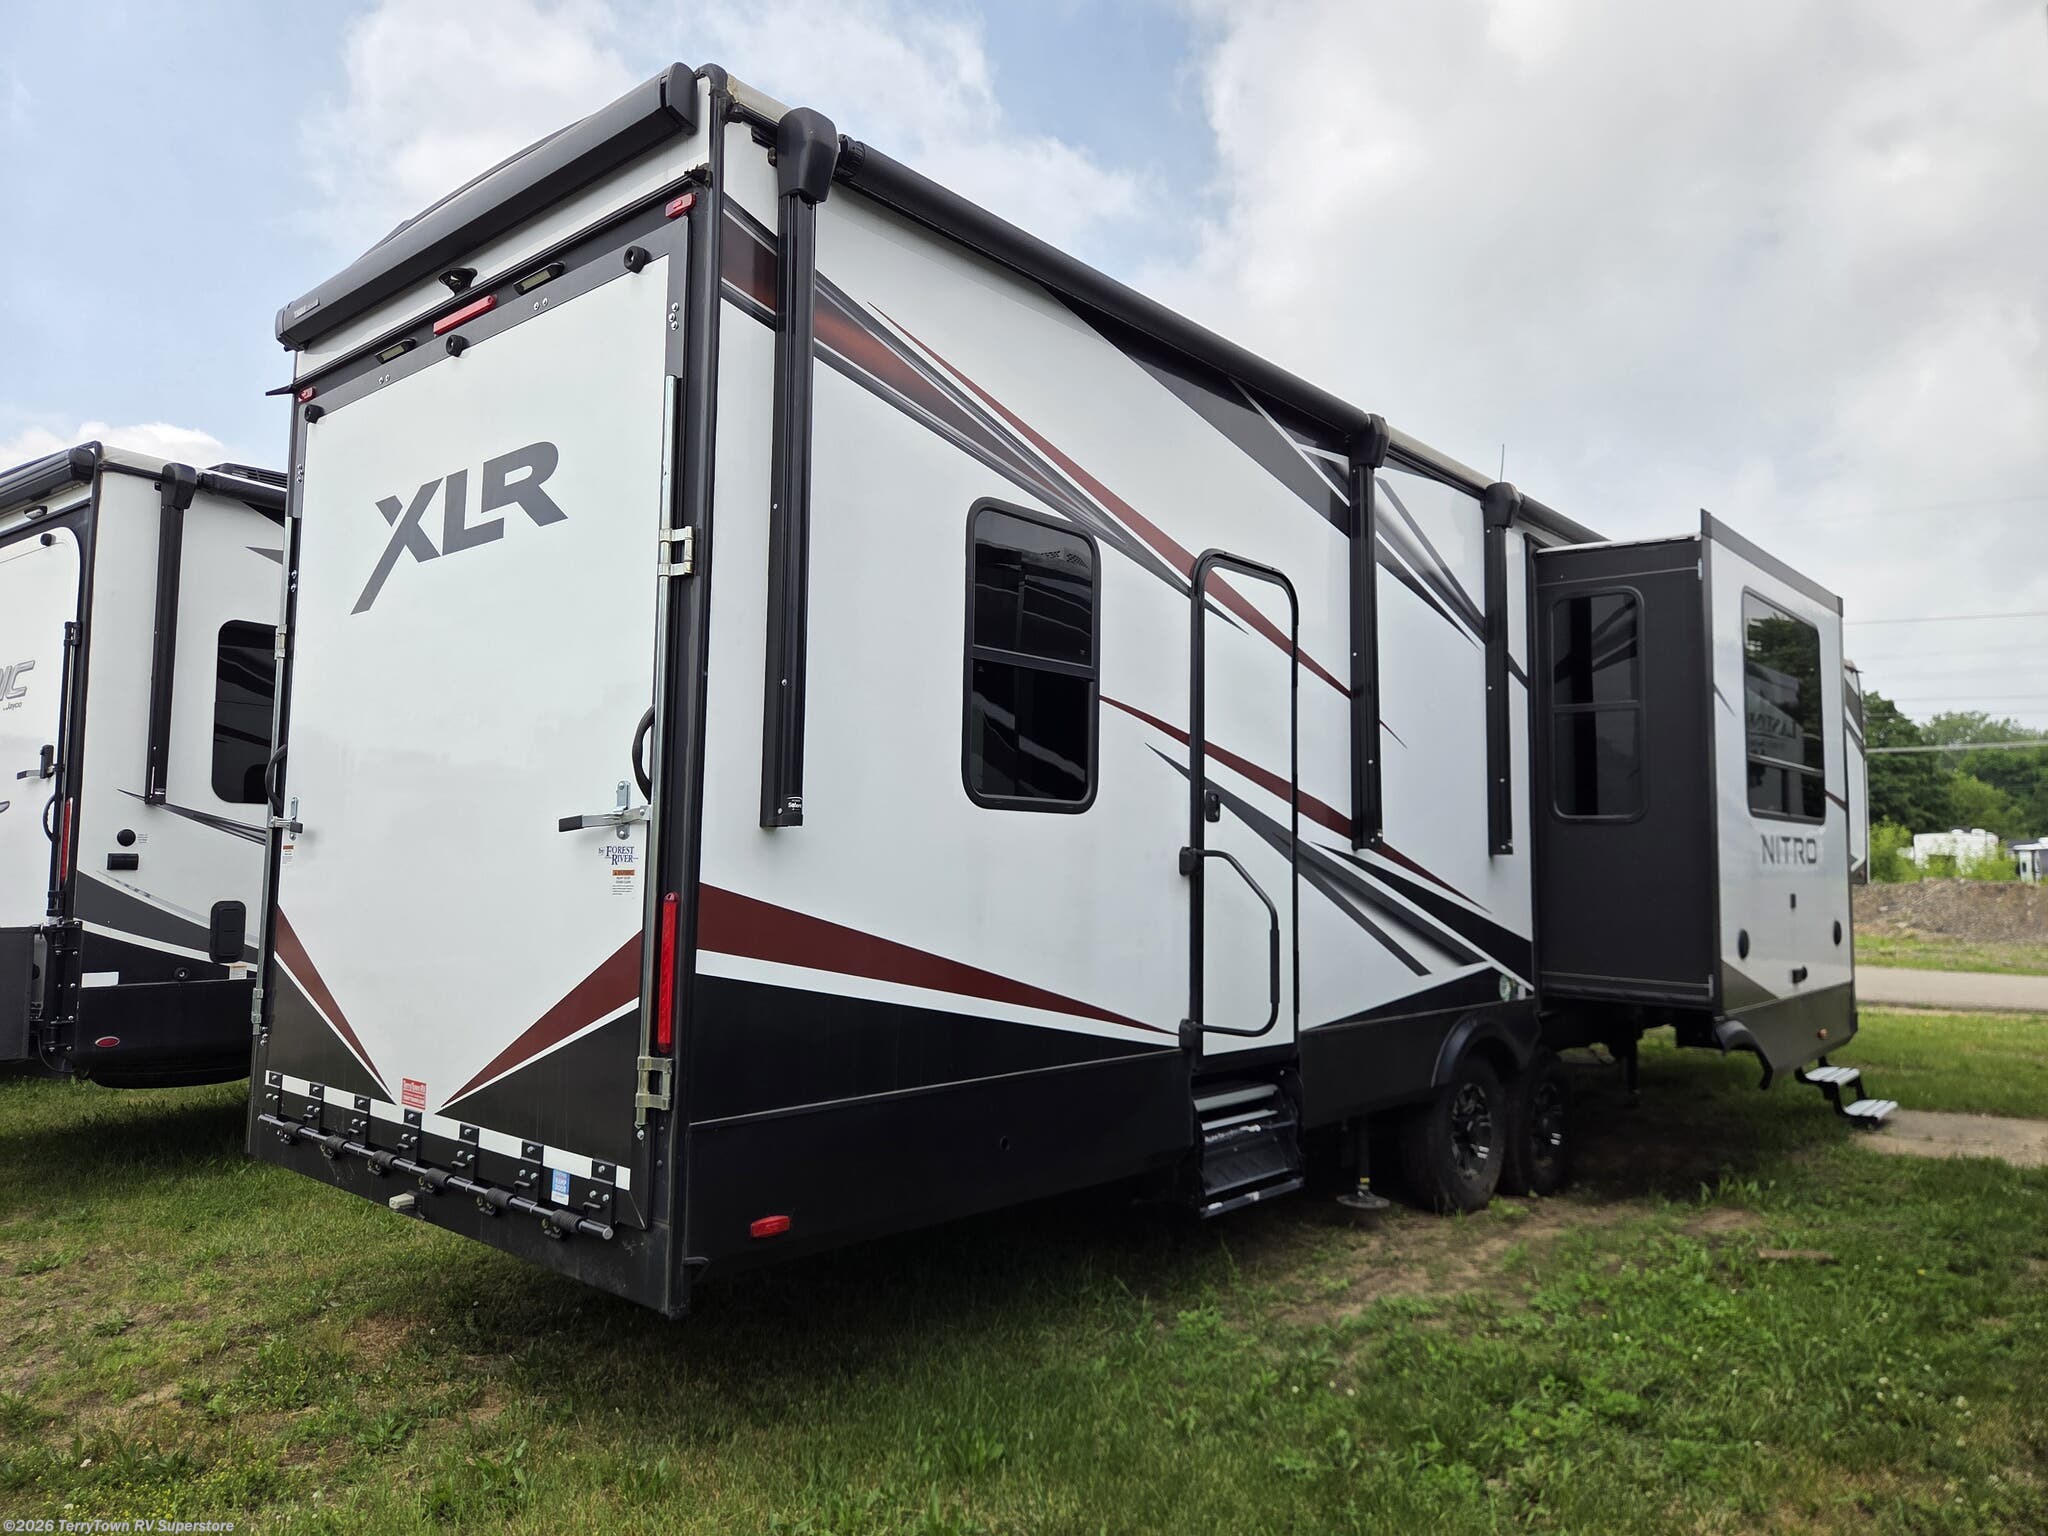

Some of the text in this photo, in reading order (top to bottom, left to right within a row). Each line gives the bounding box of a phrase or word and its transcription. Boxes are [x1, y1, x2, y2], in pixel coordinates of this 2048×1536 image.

[350, 441, 568, 616] XLR
[606, 846, 635, 856] FOREST
[1760, 834, 1817, 865] NITRO
[611, 855, 633, 865] RIVER
